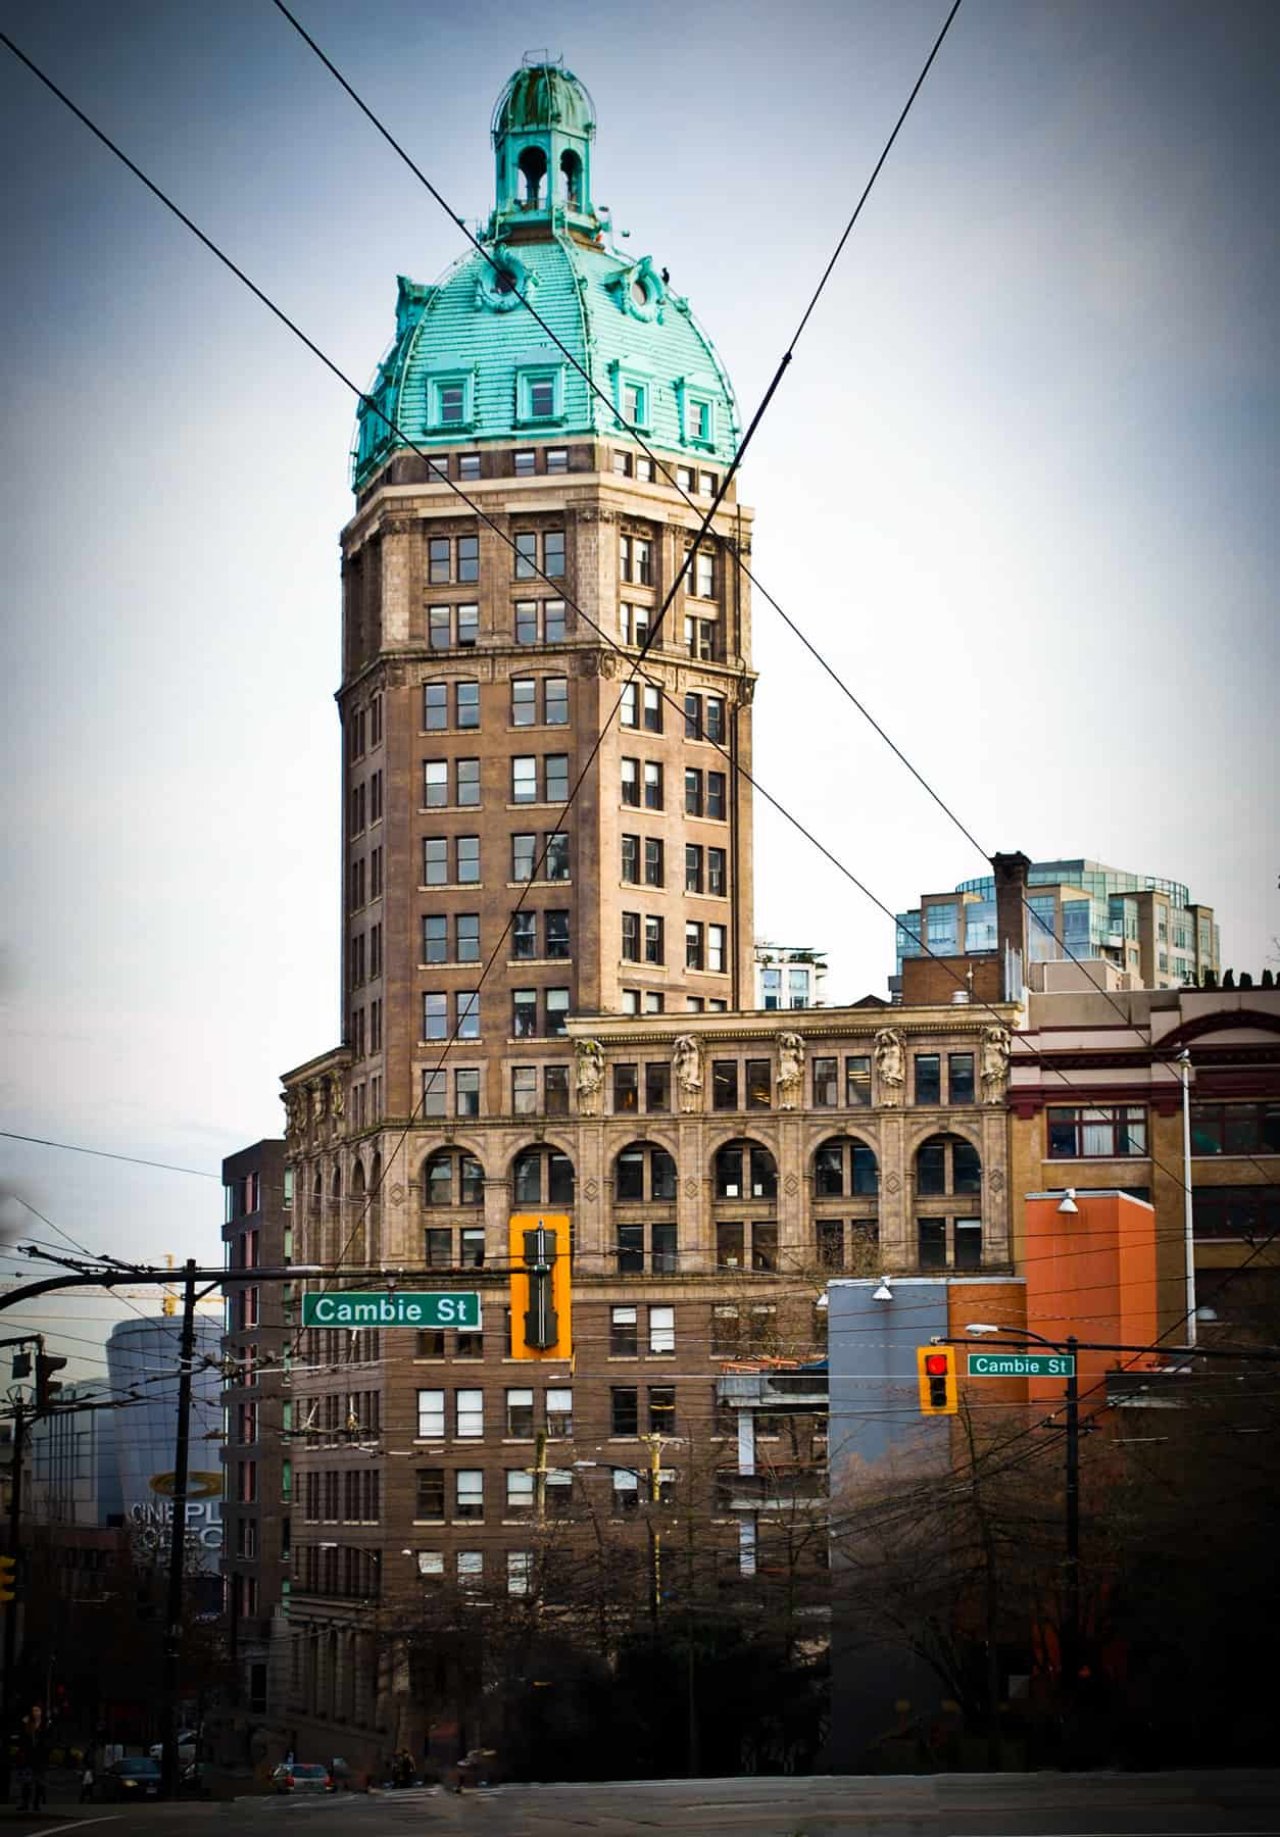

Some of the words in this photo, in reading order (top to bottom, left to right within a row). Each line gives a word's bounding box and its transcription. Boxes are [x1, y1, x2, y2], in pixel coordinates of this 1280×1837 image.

[315, 1298, 422, 1321] Cambie
[437, 1298, 467, 1321] St
[976, 1358, 1040, 1373] Cambie
[1048, 1359, 1066, 1373] St
